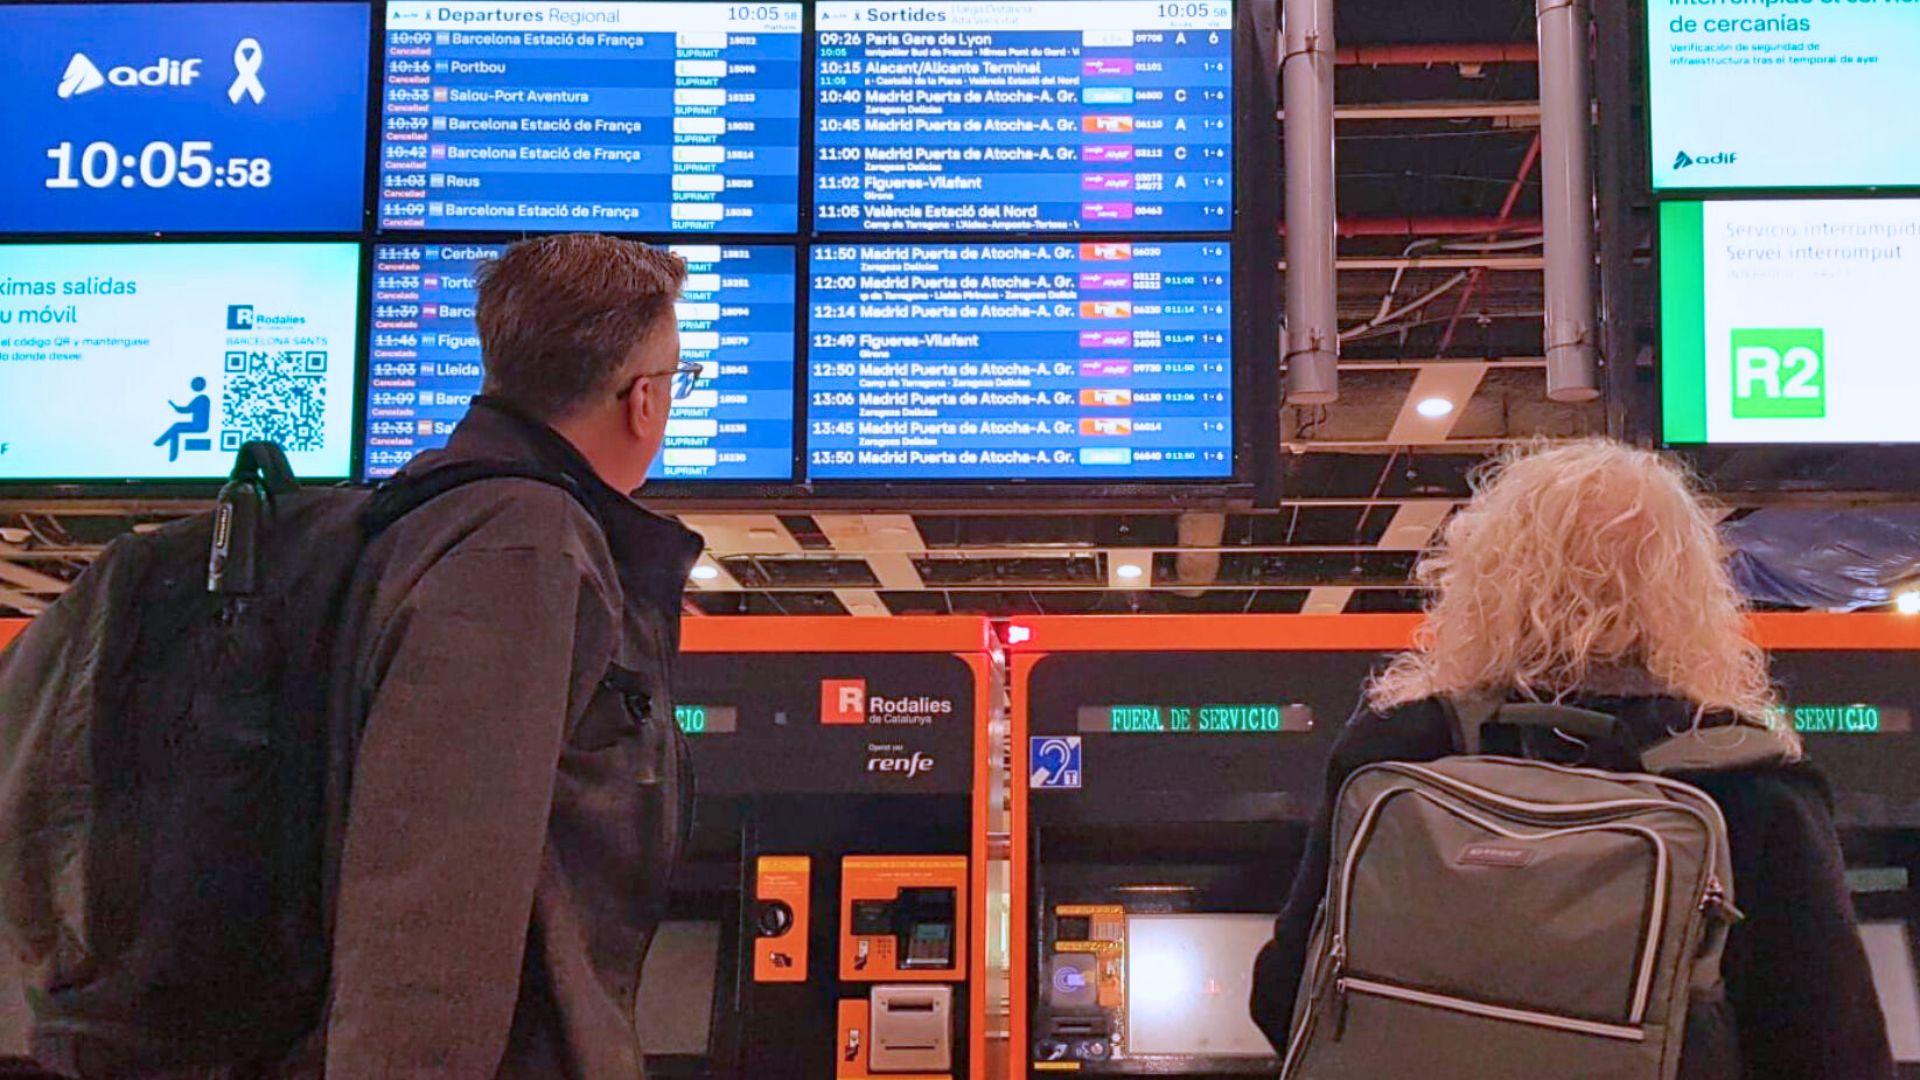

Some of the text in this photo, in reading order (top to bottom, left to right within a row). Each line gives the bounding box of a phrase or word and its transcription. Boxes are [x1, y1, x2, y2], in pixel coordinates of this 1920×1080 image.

[438, 8, 544, 24] Departures
[549, 8, 620, 25] Regional
[728, 7, 779, 20] 10:05
[867, 7, 946, 21] Sortides
[1158, 4, 1208, 17] 10:05
[1669, 13, 1810, 33] de cercanías
[452, 33, 520, 45] Barcelona
[524, 33, 574, 45] Estació
[577, 33, 594, 45] de
[598, 34, 644, 48] França
[820, 33, 992, 48] 09:26 Paris Gare de Lyon
[1175, 31, 1219, 44] A 6
[676, 49, 719, 58] SUPRIMIT
[1669, 42, 1820, 53] Verificación de seguridad de
[451, 61, 506, 73] Portbou
[1669, 55, 1879, 66] infraestructura tras el temporal de ayer
[108, 57, 202, 86] adif
[821, 61, 1041, 76] 10:15 Alacant/Alicante Terminal
[450, 89, 523, 101] Salou-Port
[527, 91, 589, 102] Aventura
[820, 90, 1077, 103] 10:40 Madrid Puerta de Atocha-A. Gr.
[1175, 89, 1186, 102] C
[449, 118, 518, 130] Barcelona
[521, 118, 571, 131] Estació
[574, 119, 592, 131] de
[595, 119, 641, 134] França
[820, 118, 1077, 131] 10:45 Madrid Puerta de Atocha-A. Gr.
[1175, 118, 1186, 131] A
[448, 147, 516, 158] Barcelona
[520, 147, 570, 159] Estació
[573, 148, 591, 159] de
[594, 148, 640, 162] França
[819, 147, 860, 160] 11:00
[1175, 146, 1186, 159] C
[1696, 152, 1737, 165] adif
[45, 141, 271, 188] 10:05:58
[447, 176, 480, 187] Reus
[819, 176, 982, 191] 11:02 Figueres-Vilafant
[1175, 175, 1186, 189] A
[673, 192, 716, 201] SUPRIMIT
[446, 204, 515, 216] Barcelona
[518, 204, 568, 217] Estació
[572, 205, 589, 217] de
[592, 205, 639, 220] França
[818, 205, 1037, 218] 11:05 València Estació del Nord
[1803, 222, 1920, 240] interrumpid
[441, 247, 498, 260] Cerbère
[815, 247, 1075, 260] 11:50 Madrid Puerta de Atocha-A. Gr.
[62, 276, 137, 295] salidas
[814, 277, 856, 289] 12:00
[18, 305, 77, 324] móvil
[439, 305, 476, 317] Barc
[814, 306, 856, 318] 12:14
[256, 314, 306, 325] Rodalies
[13, 337, 51, 349] código
[54, 337, 70, 347] QR
[82, 337, 150, 348] manténgase
[814, 334, 979, 349] 12:49 Figueres-Vilafant
[12, 352, 46, 361] donde
[437, 363, 480, 376] Lleida
[813, 363, 855, 376] 12:50
[1736, 346, 1821, 398] R2
[813, 392, 854, 405] 13:06
[812, 422, 854, 435] 13:45
[812, 451, 854, 464] 13:50
[839, 687, 951, 713] R Rodalies
[869, 714, 932, 725] de Catalunya
[1112, 707, 1279, 730] FUERA DE SERVICIO
[1794, 708, 1878, 731] SERVICIO
[867, 752, 934, 778] renfe
